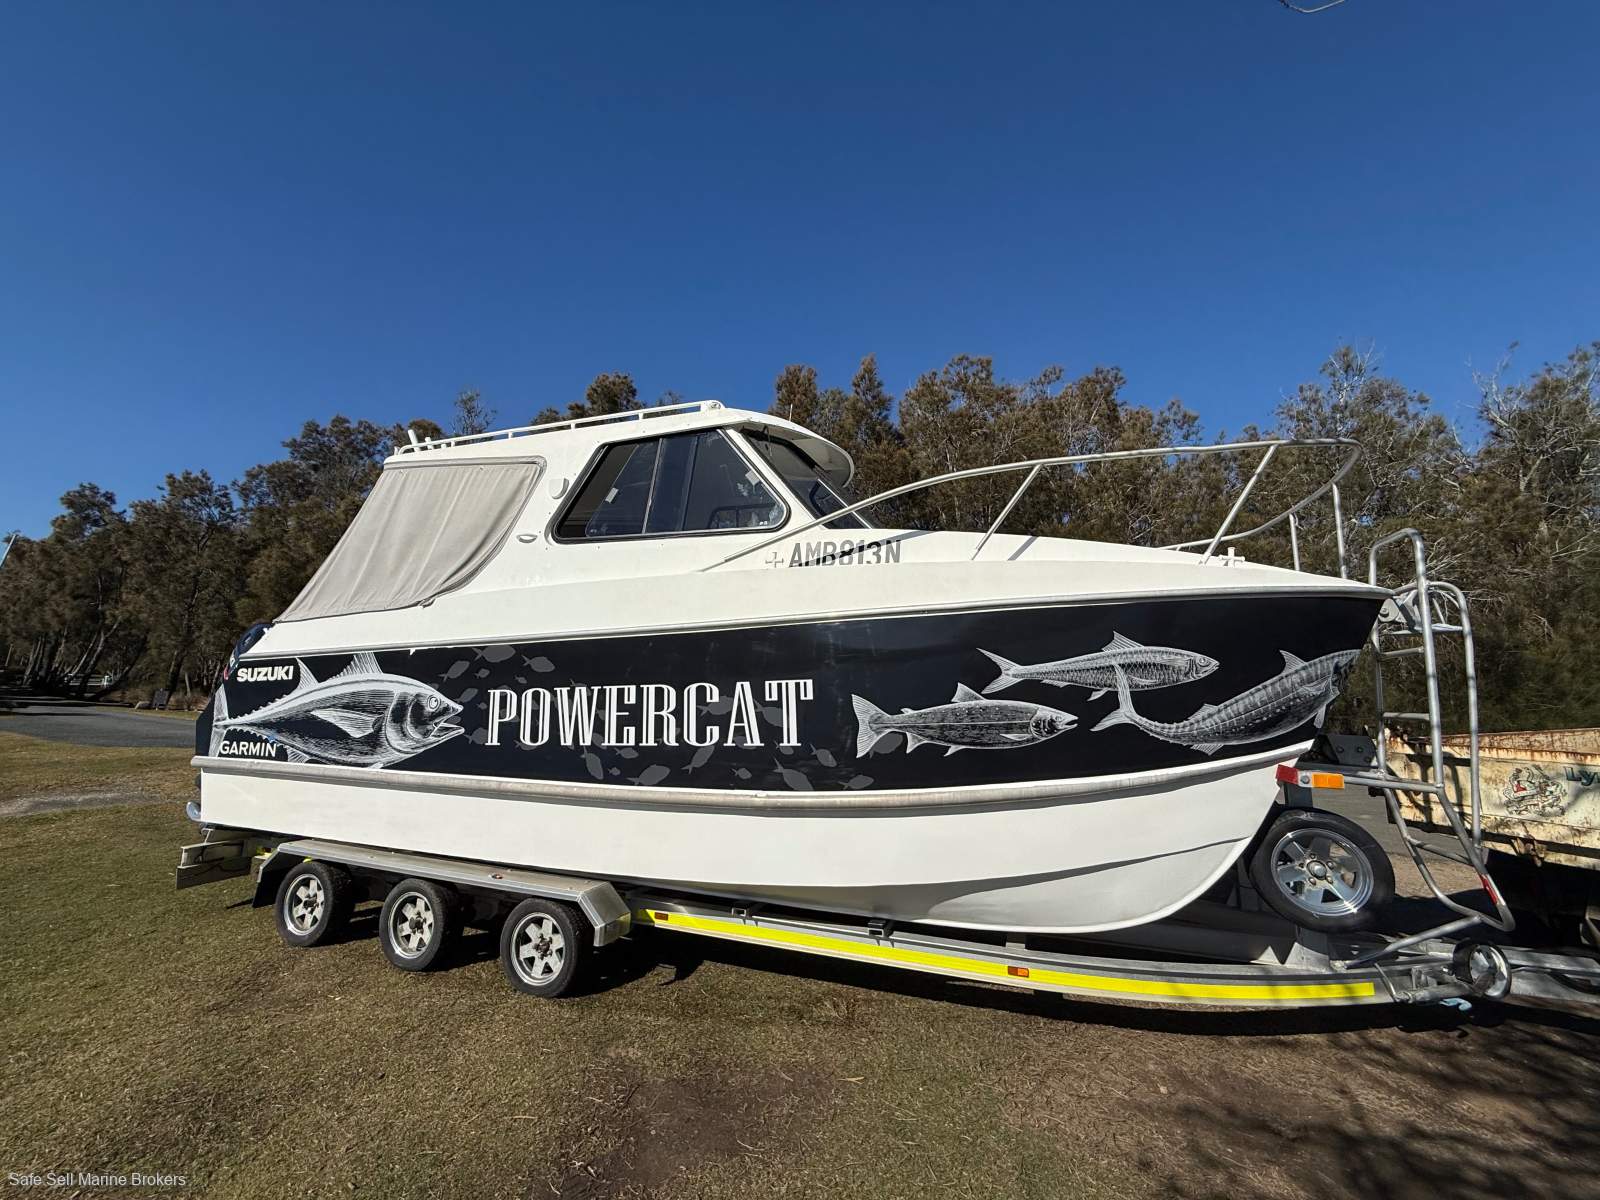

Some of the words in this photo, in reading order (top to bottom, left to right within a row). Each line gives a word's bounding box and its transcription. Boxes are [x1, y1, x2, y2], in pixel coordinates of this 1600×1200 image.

[789, 539, 901, 568] AMB813N
[236, 665, 294, 683] SUZUKI
[485, 679, 813, 746] POWERCAT
[219, 740, 277, 757] GARMIN
[1563, 766, 1600, 787] Ly
